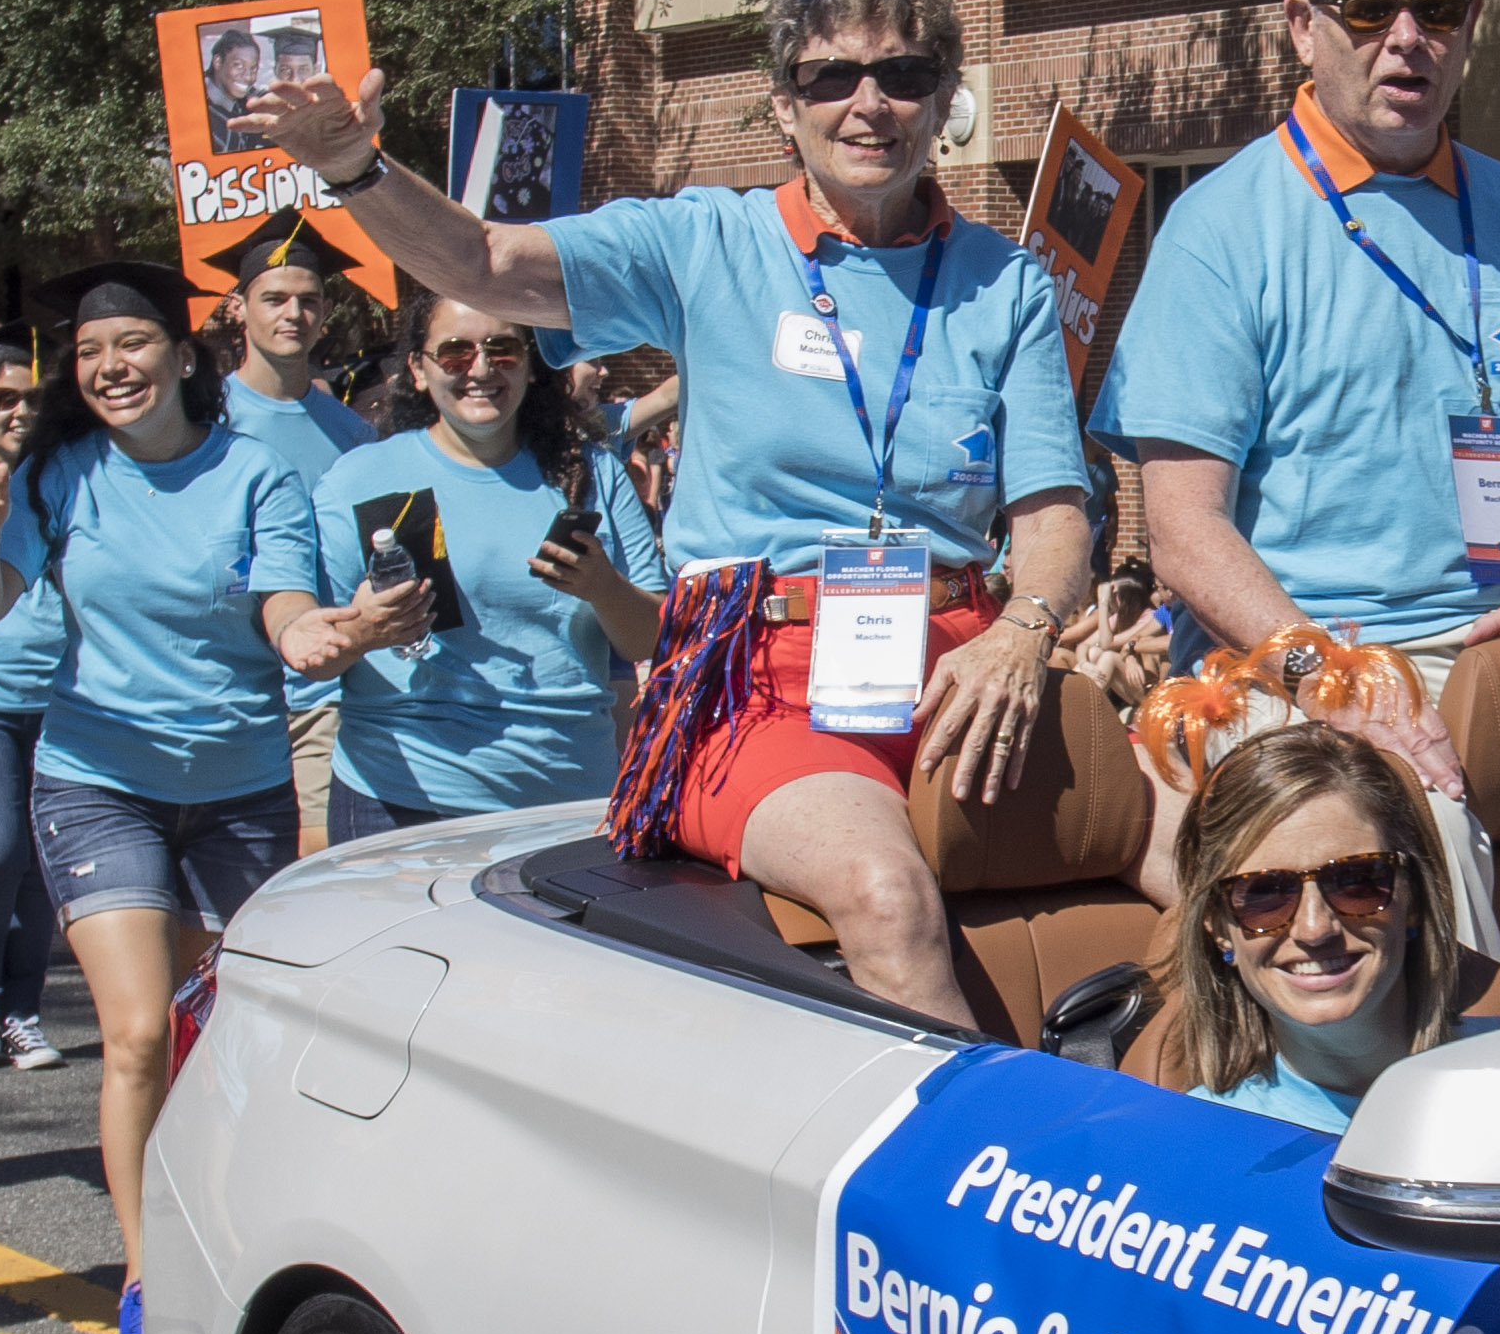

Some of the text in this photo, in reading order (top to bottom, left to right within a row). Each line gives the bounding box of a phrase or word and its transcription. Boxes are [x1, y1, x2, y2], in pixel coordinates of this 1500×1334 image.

[876, 565, 909, 573] FLORIDA
[882, 571, 923, 579] SCHOLARS
[856, 615, 893, 626] Chris
[946, 1145, 1217, 1290] President
